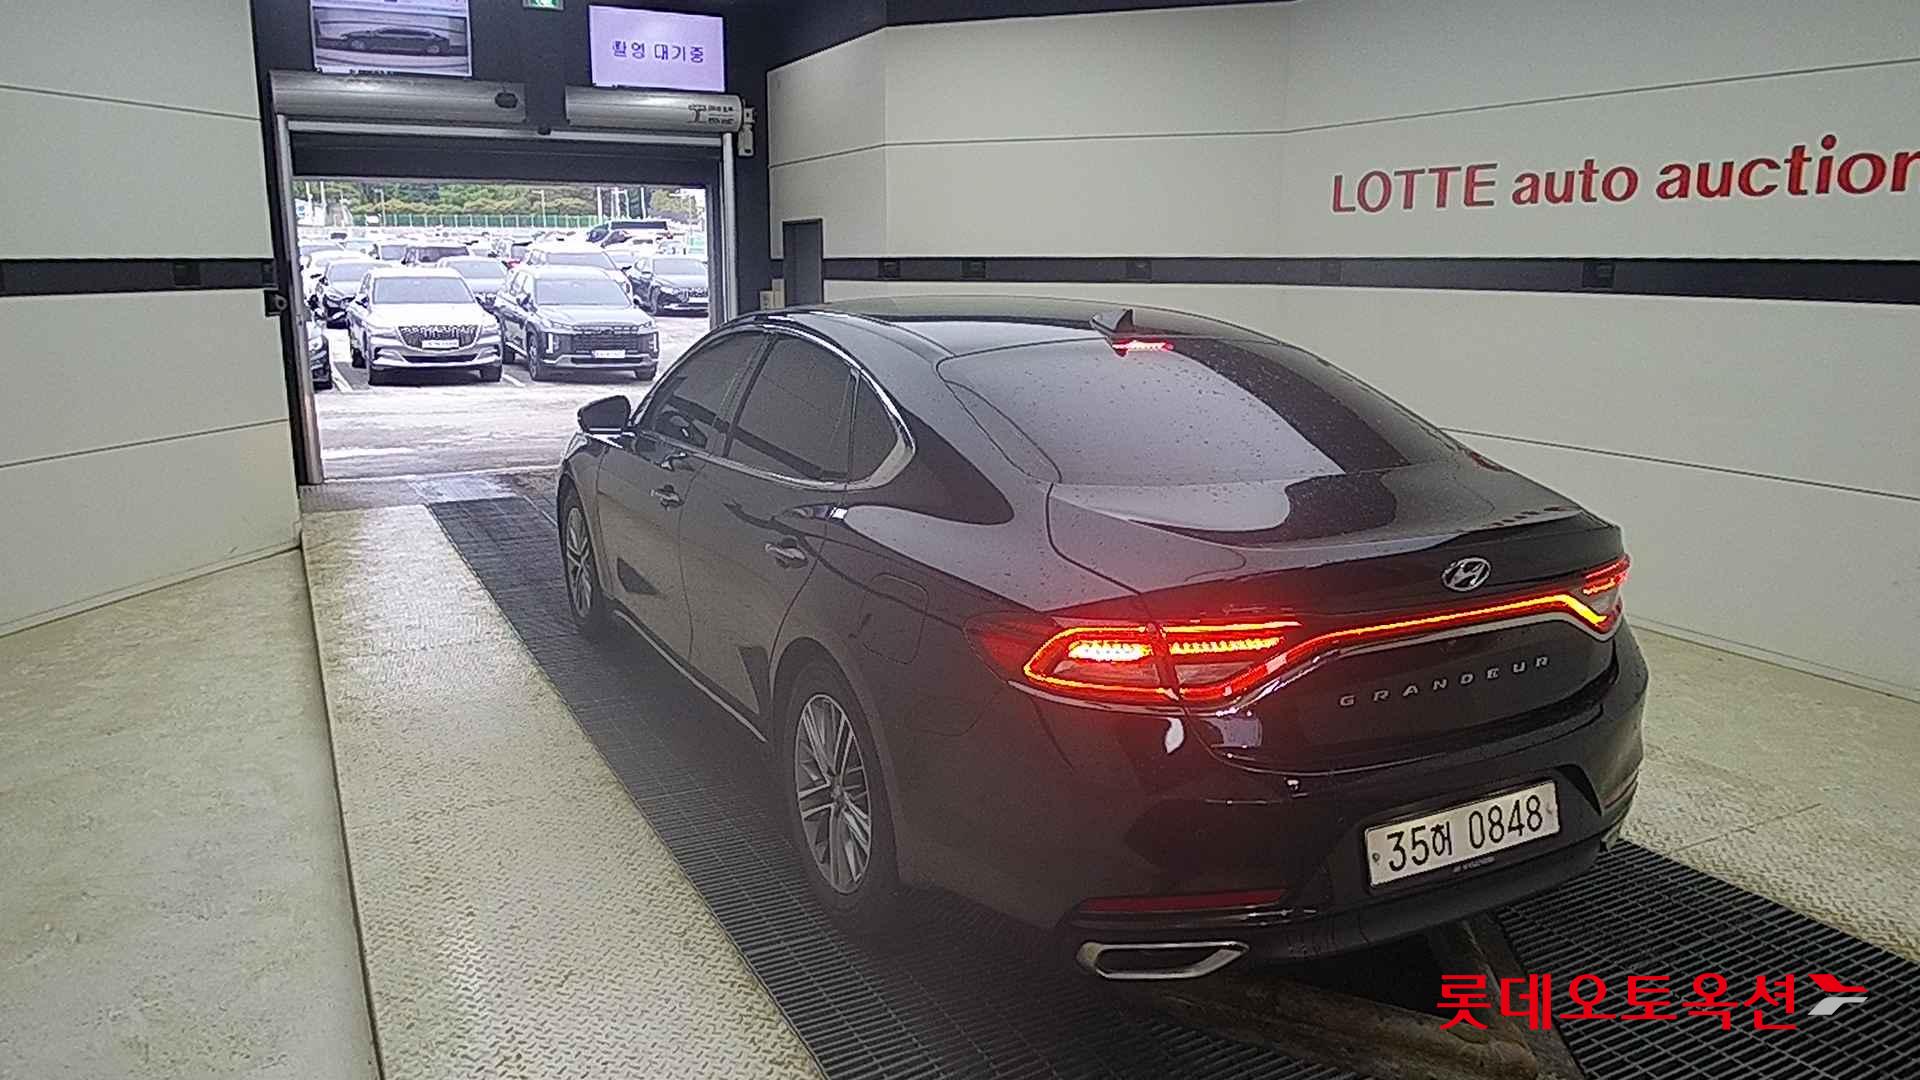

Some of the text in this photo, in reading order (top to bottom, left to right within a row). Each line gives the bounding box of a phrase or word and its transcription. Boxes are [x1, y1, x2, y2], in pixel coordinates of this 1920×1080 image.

[612, 40, 705, 64] 촬영 대기중
[1331, 162, 1499, 214] LOTTE
[1512, 158, 1638, 206] auto
[1338, 655, 1549, 707] GRANDEUR
[1386, 794, 1544, 873] 35허 0848
